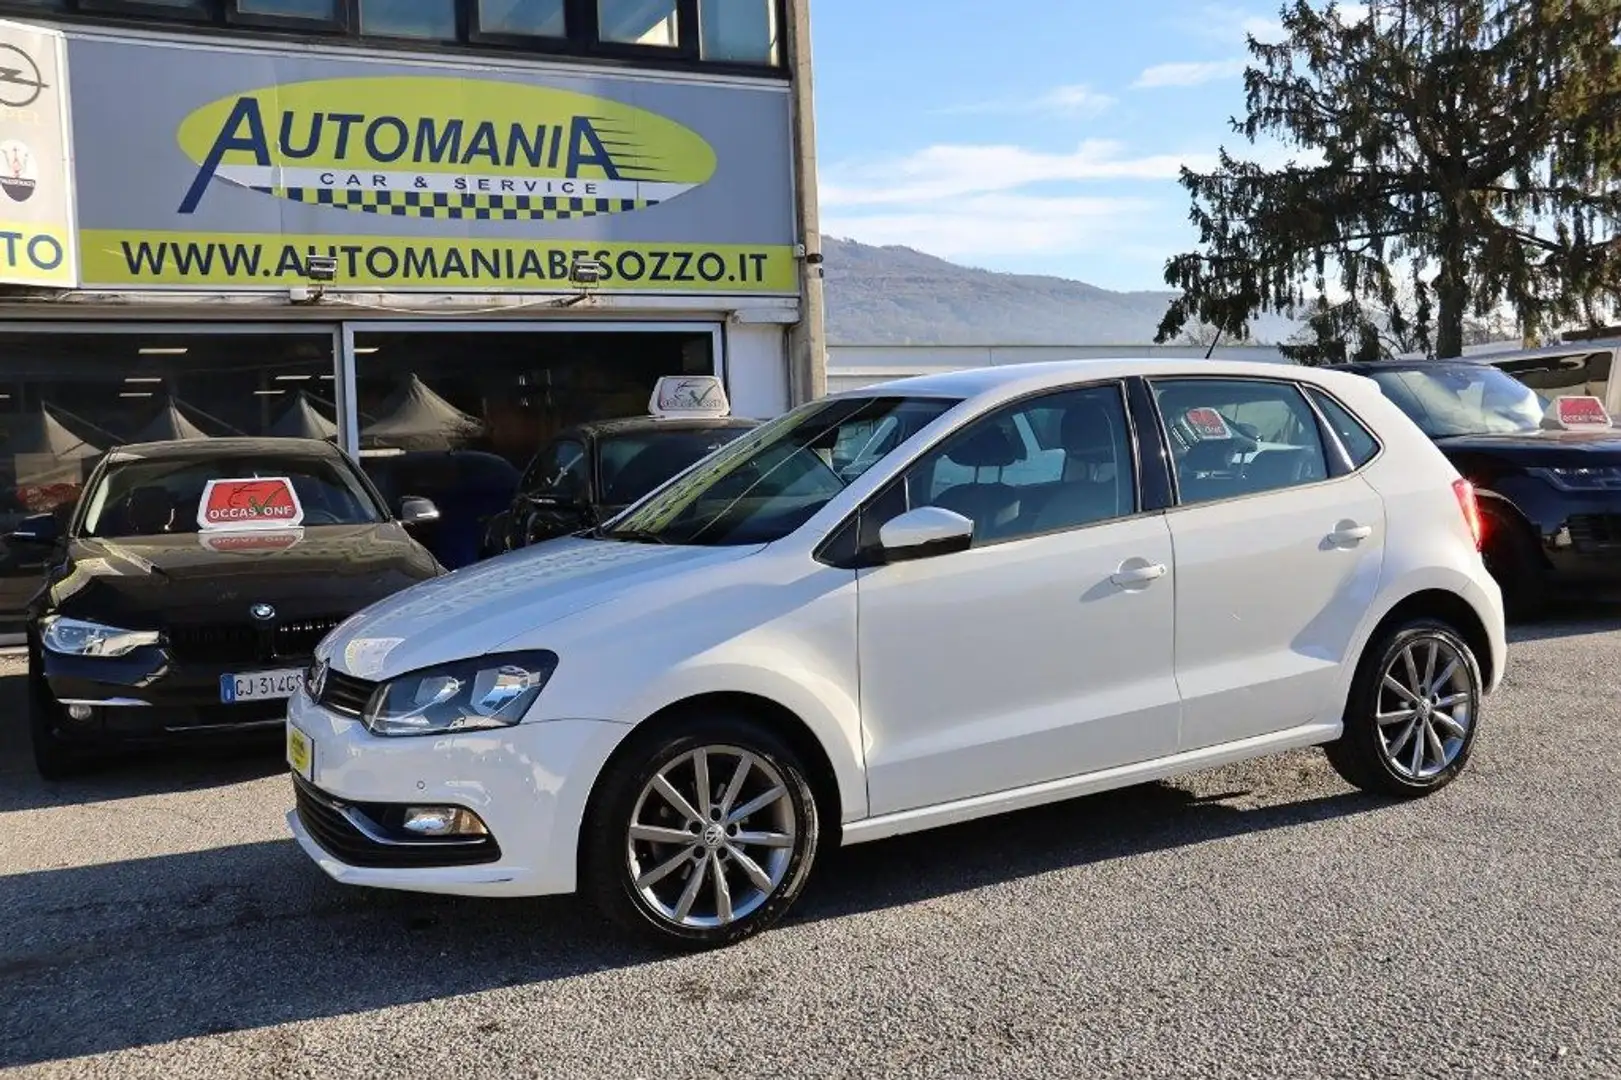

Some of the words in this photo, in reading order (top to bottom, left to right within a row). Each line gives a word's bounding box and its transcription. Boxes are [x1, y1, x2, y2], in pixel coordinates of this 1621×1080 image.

[177, 97, 620, 214] AUTOMANIA
[319, 173, 387, 187] CAR
[413, 176, 428, 189] &
[453, 177, 598, 195] SERVICE
